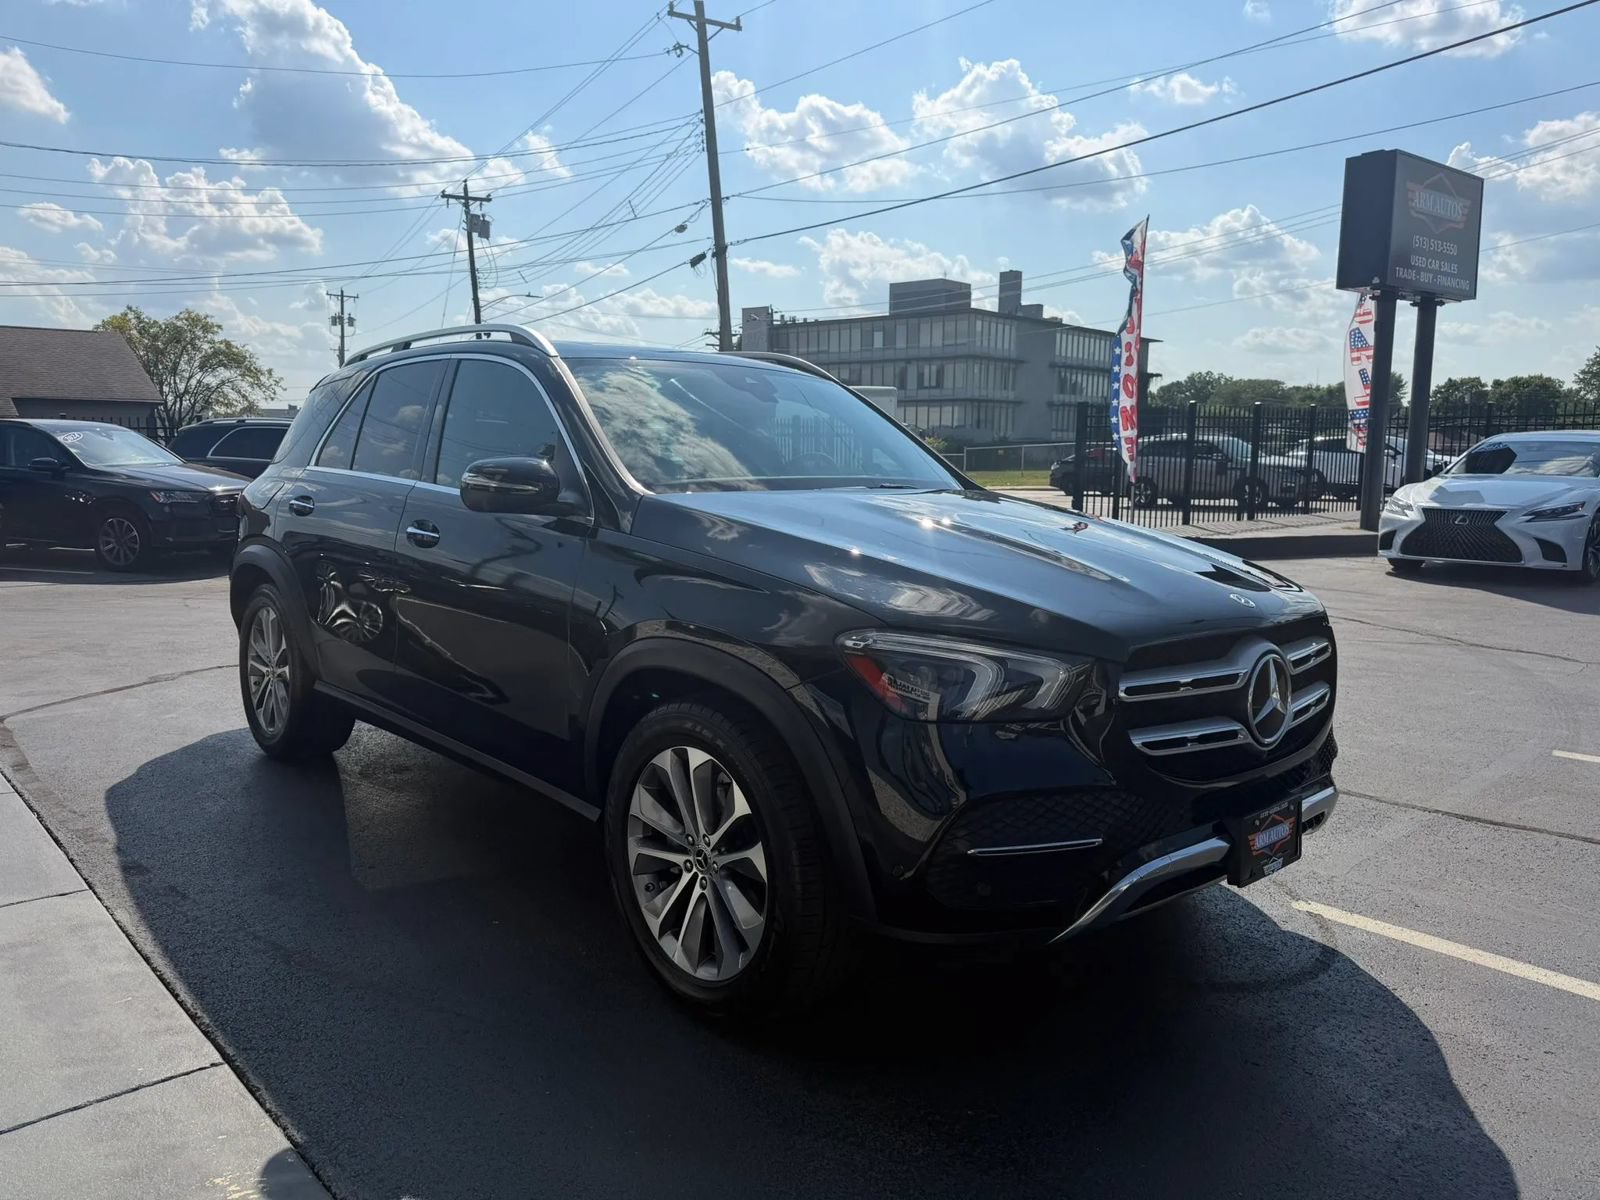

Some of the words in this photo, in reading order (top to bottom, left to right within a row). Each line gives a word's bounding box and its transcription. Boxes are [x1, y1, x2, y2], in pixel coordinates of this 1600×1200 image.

[1434, 197, 1464, 218] AUTOS
[1412, 234, 1429, 251] (513)
[1430, 239, 1458, 256] 513-5550
[1410, 255, 1426, 267] USED
[1427, 259, 1440, 271] CAR
[1440, 262, 1458, 274] SALES
[1395, 267, 1416, 281] TRADE
[1420, 272, 1434, 283] BUY
[1437, 275, 1470, 290] FINANCING
